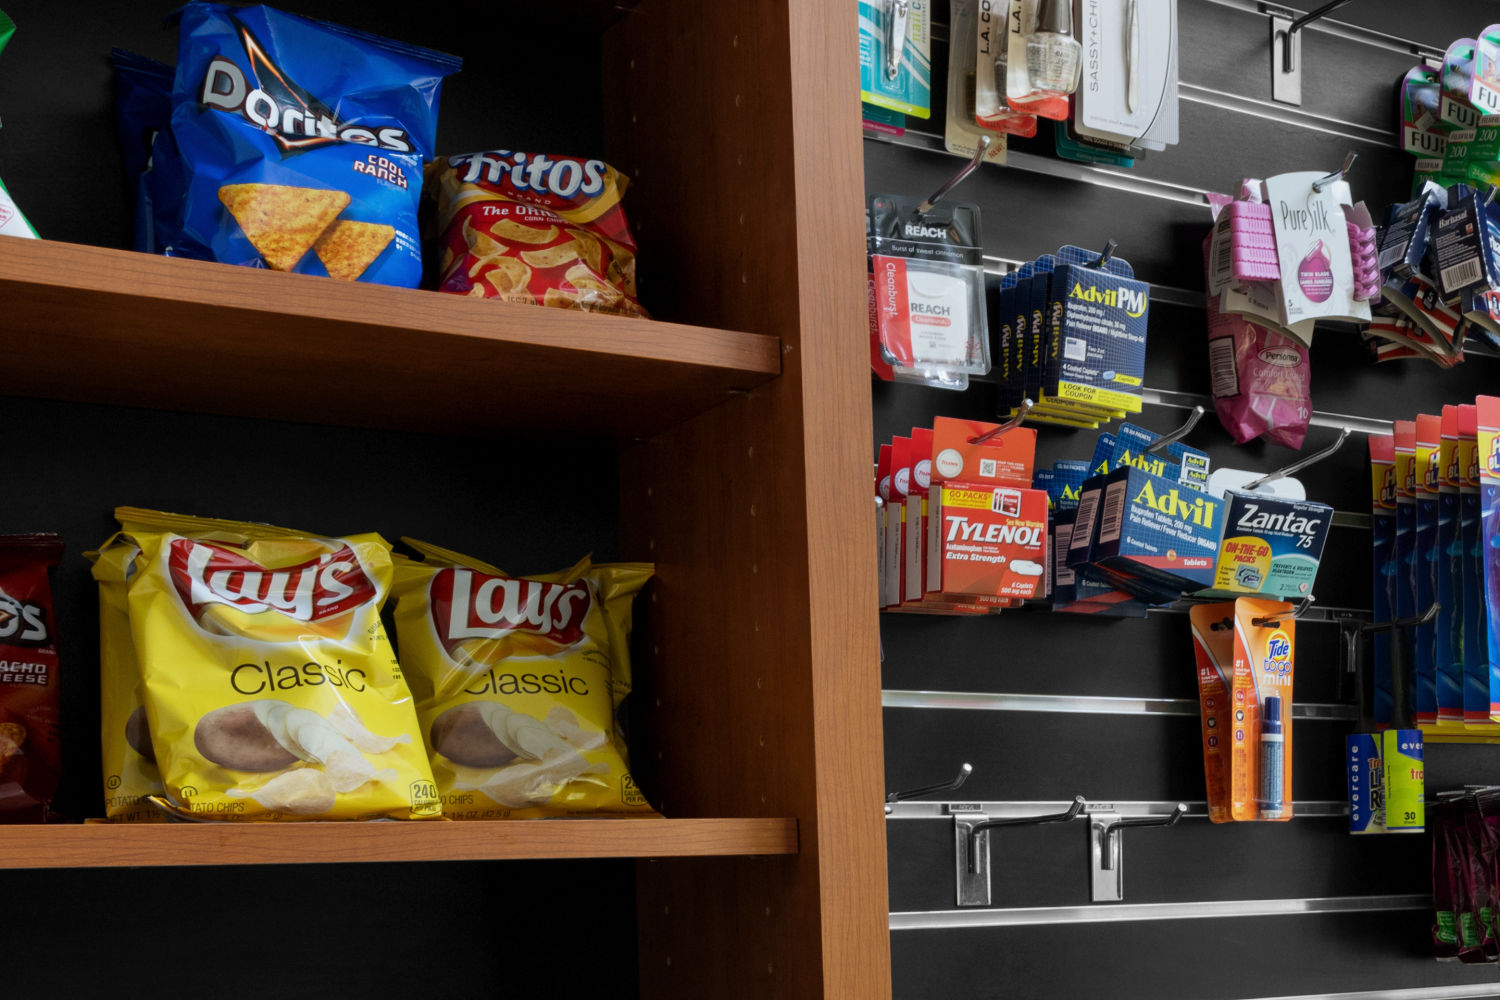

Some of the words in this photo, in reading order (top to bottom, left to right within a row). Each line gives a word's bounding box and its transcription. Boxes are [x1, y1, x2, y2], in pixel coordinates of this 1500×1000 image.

[201, 58, 410, 153] Doritos
[1478, 129, 1498, 142] 200
[368, 154, 405, 179] COOL
[450, 151, 606, 197] Fritos
[353, 160, 408, 189] RANCH
[482, 205, 509, 216] The
[1438, 209, 1468, 229] Barbasol
[905, 225, 946, 238] REACH
[1068, 282, 1117, 307] Advil
[1117, 287, 1143, 314] PM
[911, 302, 951, 316] REACH
[1265, 351, 1298, 363] Personna
[1064, 390, 1093, 400] COUPON
[1297, 407, 1308, 419] 10
[949, 491, 961, 499] GO
[962, 492, 988, 500] PACKS
[1132, 479, 1214, 529] Advil
[1237, 503, 1321, 535] Zantac
[946, 516, 1042, 547] TYLENOL
[1225, 542, 1270, 557] ON-THE-GO
[1296, 535, 1315, 549] 75
[946, 552, 968, 561] Extra
[970, 554, 1006, 564] Strength
[1183, 558, 1207, 566] Tablets
[1233, 555, 1256, 564] PACKS
[191, 543, 356, 622] Lay's
[449, 569, 588, 640] Lay's
[1269, 639, 1290, 659] Tide
[230, 660, 366, 696] Classic
[464, 670, 589, 695] Classic
[1263, 673, 1291, 686] mini
[413, 784, 437, 799] 240
[1404, 812, 1416, 820] 30
